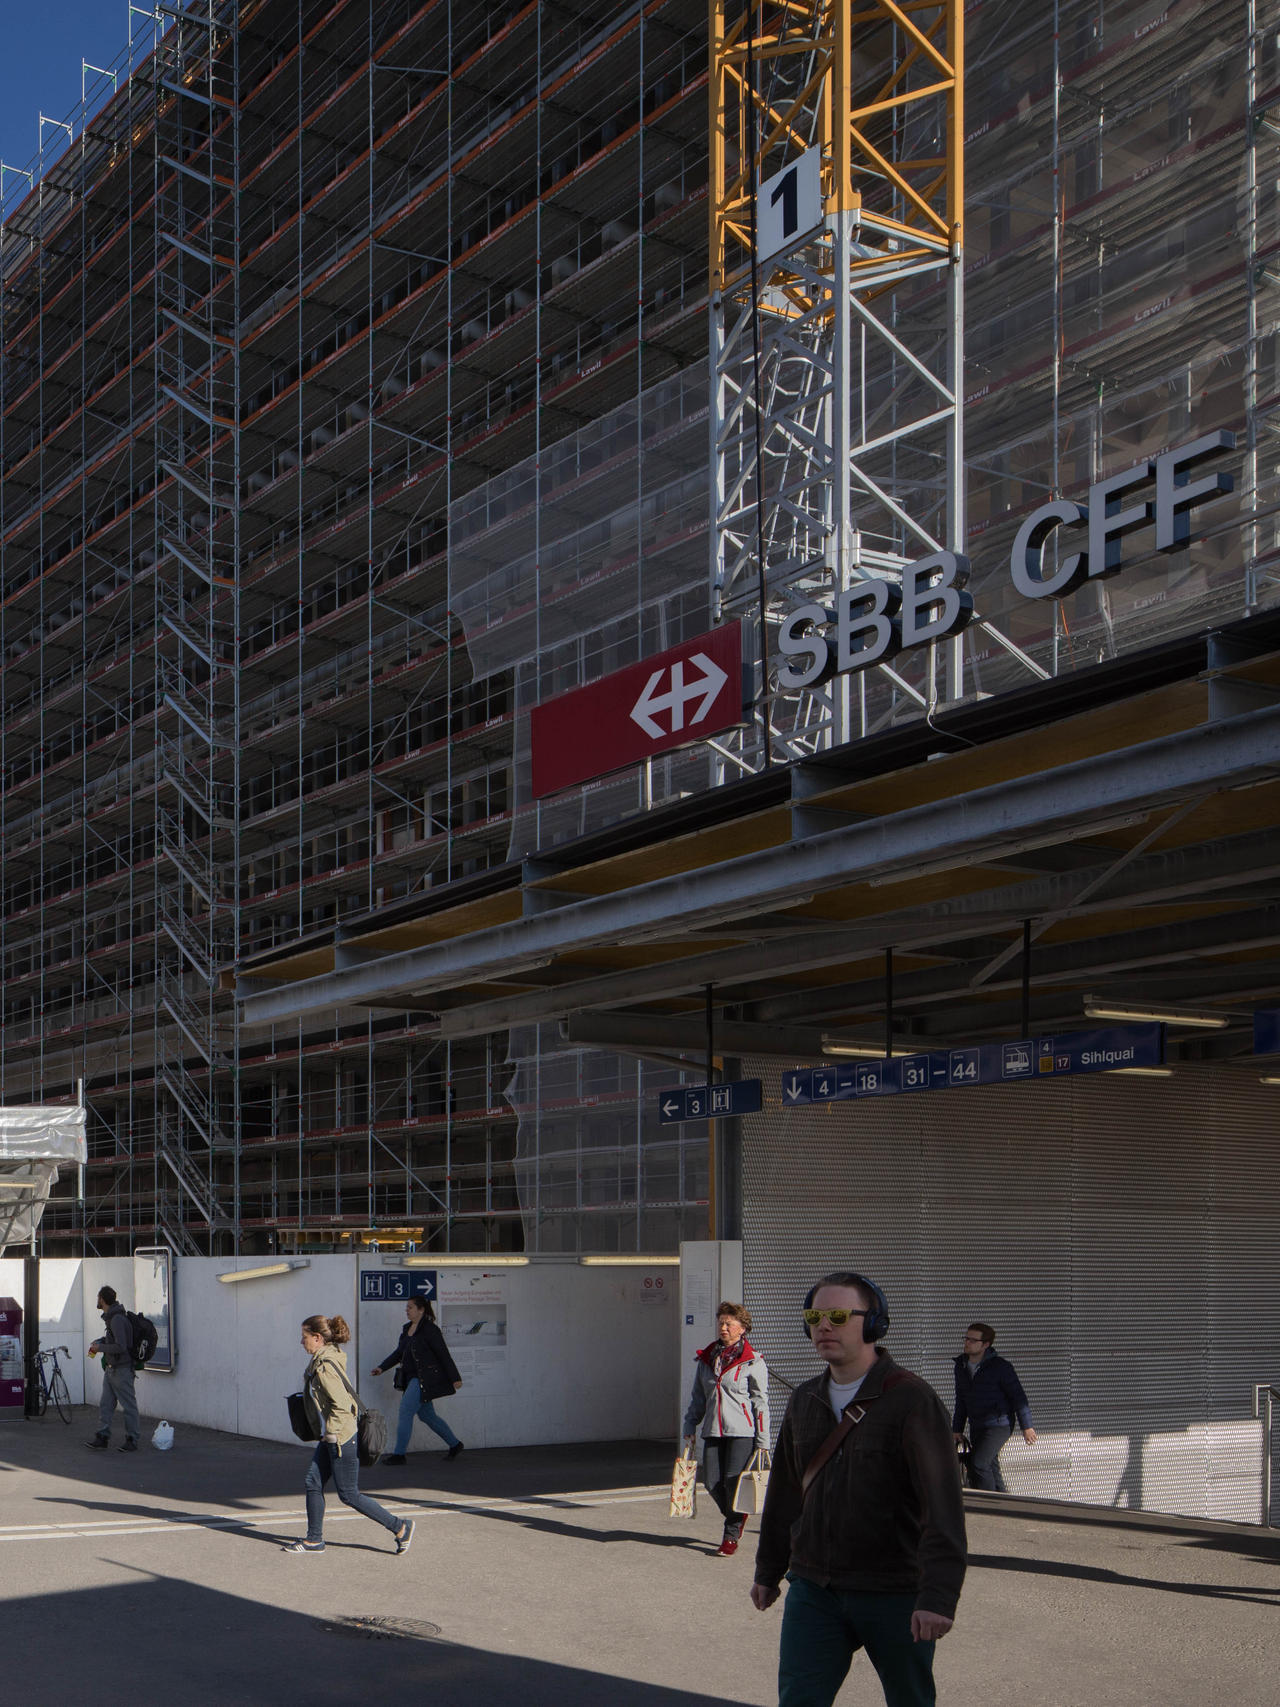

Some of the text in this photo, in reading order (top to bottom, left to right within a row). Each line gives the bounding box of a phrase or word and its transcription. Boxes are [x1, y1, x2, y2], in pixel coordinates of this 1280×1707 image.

[1135, 13, 1168, 38] Lawil
[771, 166, 798, 240] 1
[1135, 298, 1170, 321] Lawil
[581, 361, 601, 378] Lawil
[777, 428, 1228, 690] SBB CFF
[1042, 1043, 1050, 1052] 4
[1057, 1057, 1068, 1068] 17
[1081, 1046, 1135, 1065] Sihlquai
[819, 1080, 830, 1095] 4
[860, 1073, 877, 1091] 18
[907, 1067, 925, 1085] 31
[953, 1061, 977, 1079] 44
[691, 1100, 700, 1114] 3
[394, 1282, 404, 1296] 3
